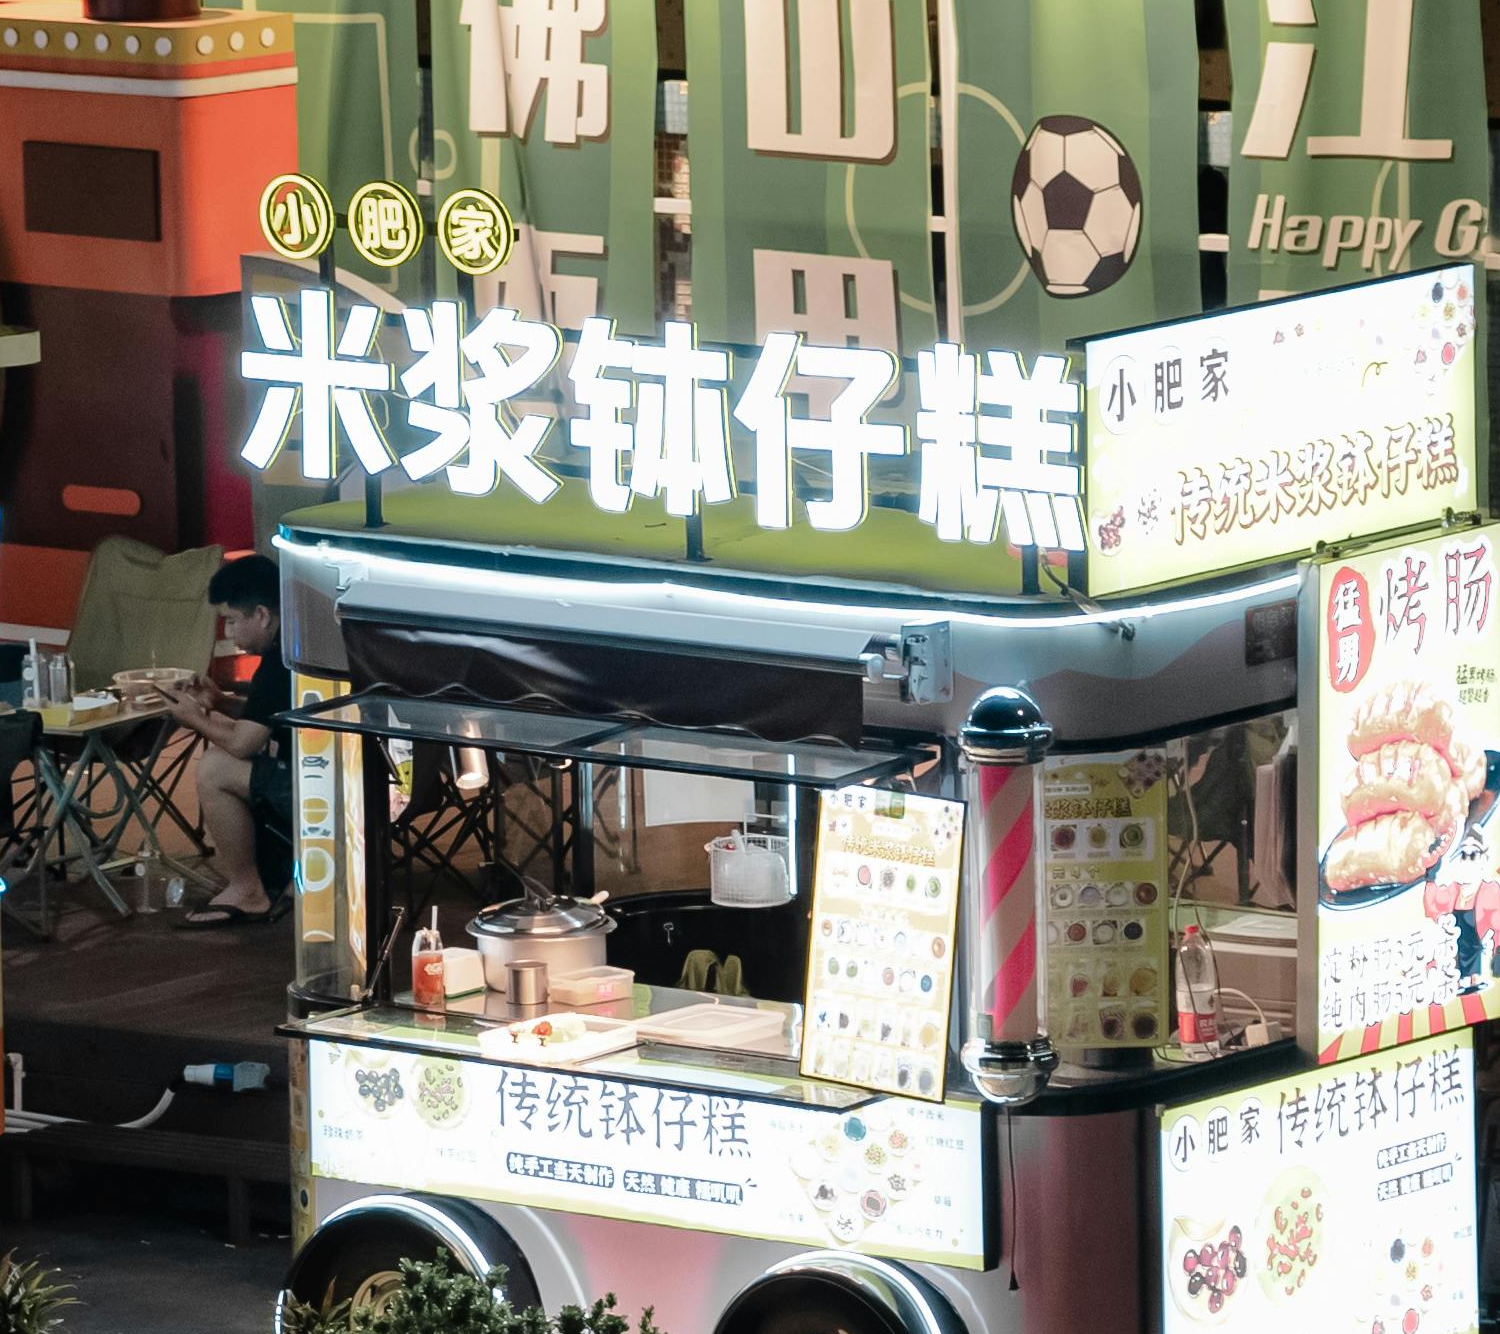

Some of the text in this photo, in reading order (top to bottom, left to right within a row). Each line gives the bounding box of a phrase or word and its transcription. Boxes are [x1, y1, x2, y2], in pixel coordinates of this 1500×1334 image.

[273, 188, 500, 263] 小肥家
[1246, 193, 1422, 272] Happy
[240, 289, 1087, 551] 米浆钵仔糕
[1107, 348, 1230, 422] 小肥家
[1171, 412, 1460, 547] 传统米浆钵仔糕
[1379, 542, 1492, 655] 烤肠
[496, 1066, 752, 1160] 传统钵仔糕
[1175, 1043, 1466, 1163] 小肥家 传统钵仔糕
